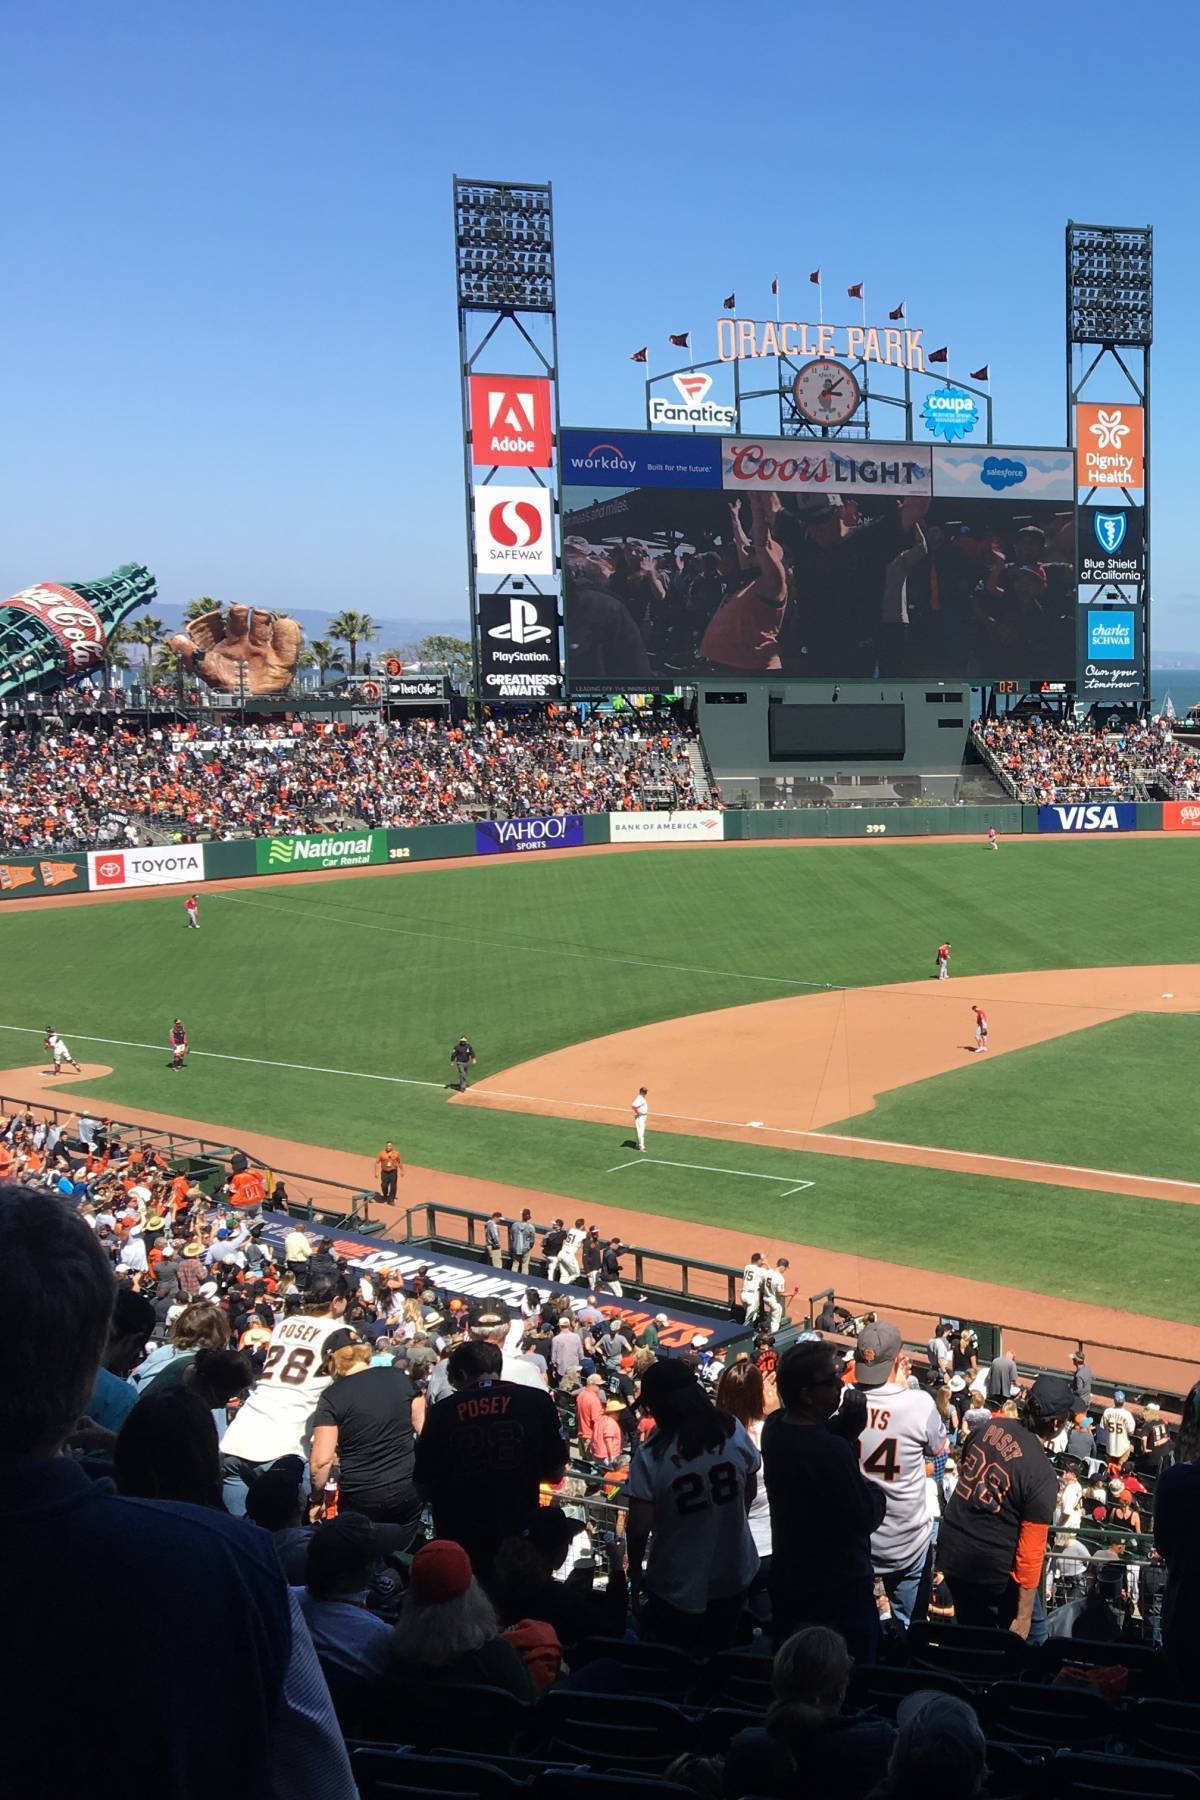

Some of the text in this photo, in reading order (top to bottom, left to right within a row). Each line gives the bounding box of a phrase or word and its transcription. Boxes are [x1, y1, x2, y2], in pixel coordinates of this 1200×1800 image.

[717, 318, 926, 372] ORACLE PARK
[653, 402, 734, 422] Fanatics
[929, 398, 972, 414] coupa
[491, 436, 534, 452] Adobe
[571, 457, 636, 472] workday
[731, 444, 916, 484] Coors LIGHT
[1086, 453, 1133, 470] Dignity
[986, 468, 1024, 478] salesforce
[490, 550, 543, 560] SAFEWAY
[1084, 558, 1137, 570] Blue Shield
[1081, 570, 1140, 580] of California
[1092, 624, 1129, 636] charles
[1092, 637, 1130, 645] SCHWAB
[493, 652, 548, 663] PlayStation
[486, 674, 556, 685] GREATNESS
[1085, 665, 1137, 681] Own your
[418, 683, 436, 695] Coffee
[1085, 678, 1140, 689] tomorrow
[1053, 806, 1118, 829] VISA
[494, 818, 567, 843] YAHOO!
[866, 824, 886, 833] 399
[294, 835, 372, 860] National
[389, 848, 410, 858] 382
[516, 841, 546, 850] SPORTS
[132, 857, 199, 873] TOYOTA
[322, 855, 370, 867] Car Rental
[566, 1234, 576, 1244] 51
[278, 1324, 321, 1344] POSEY
[262, 1344, 316, 1385] 28
[760, 1360, 774, 1371] 40
[456, 1396, 512, 1422] POSEY
[982, 1424, 1023, 1462] POSEY
[956, 1444, 1011, 1514] 28
[671, 1461, 739, 1513] 28
